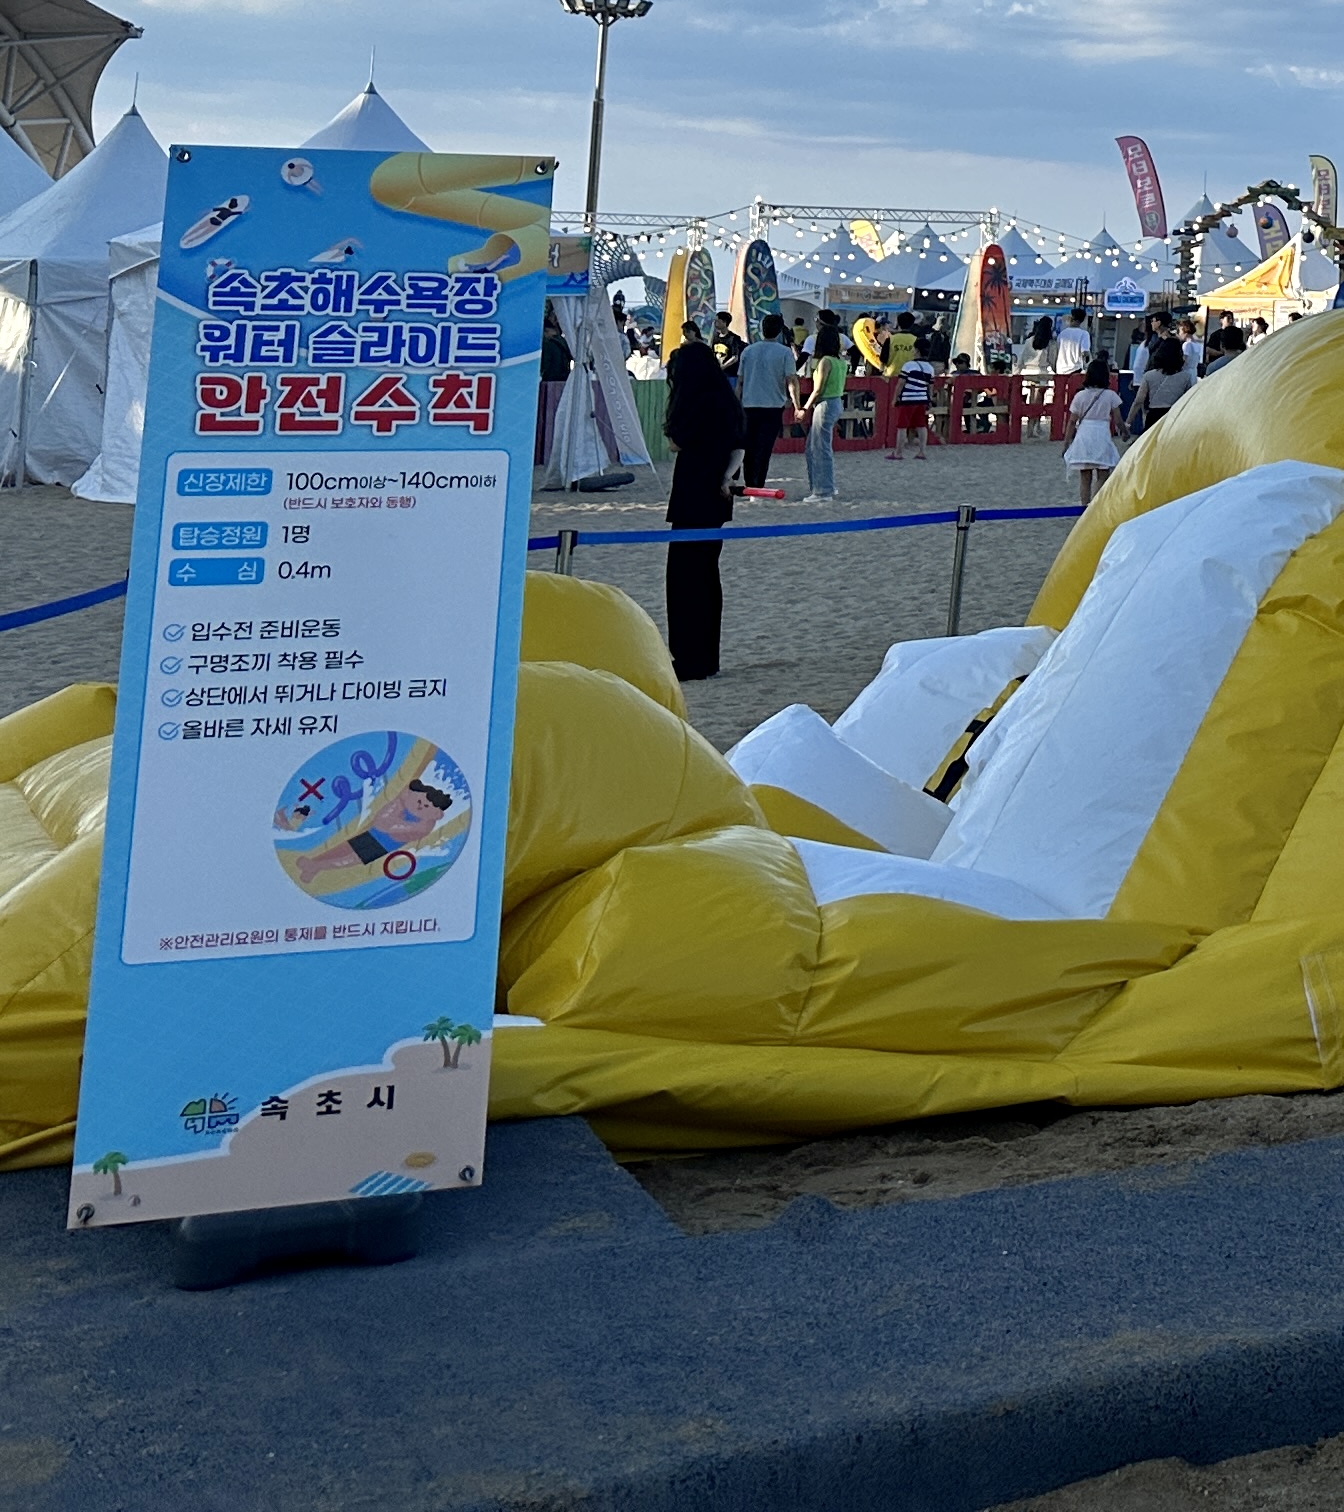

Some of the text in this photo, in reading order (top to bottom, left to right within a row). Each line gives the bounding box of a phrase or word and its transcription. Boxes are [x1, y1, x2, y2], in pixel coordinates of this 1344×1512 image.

[210, 270, 499, 317] 속초해수욕장
[199, 322, 501, 366] 워터 슬라이드
[197, 372, 497, 435] 안전수칙
[183, 470, 267, 492] 신장제한
[283, 495, 417, 510] (반드시 보호자와 동행)
[179, 524, 311, 547] 탑승정원 1명
[278, 561, 332, 580] 0.4m
[191, 618, 341, 642] 입수전 준비운동
[187, 649, 364, 675] 구명조끼 착용 필수
[185, 678, 447, 707] 상단에서 뛰거나 다이빙 금지
[182, 714, 338, 740] 올바른 자세 유지
[332, 922, 376, 938] 반드시
[380, 917, 441, 935] 지킵니다.
